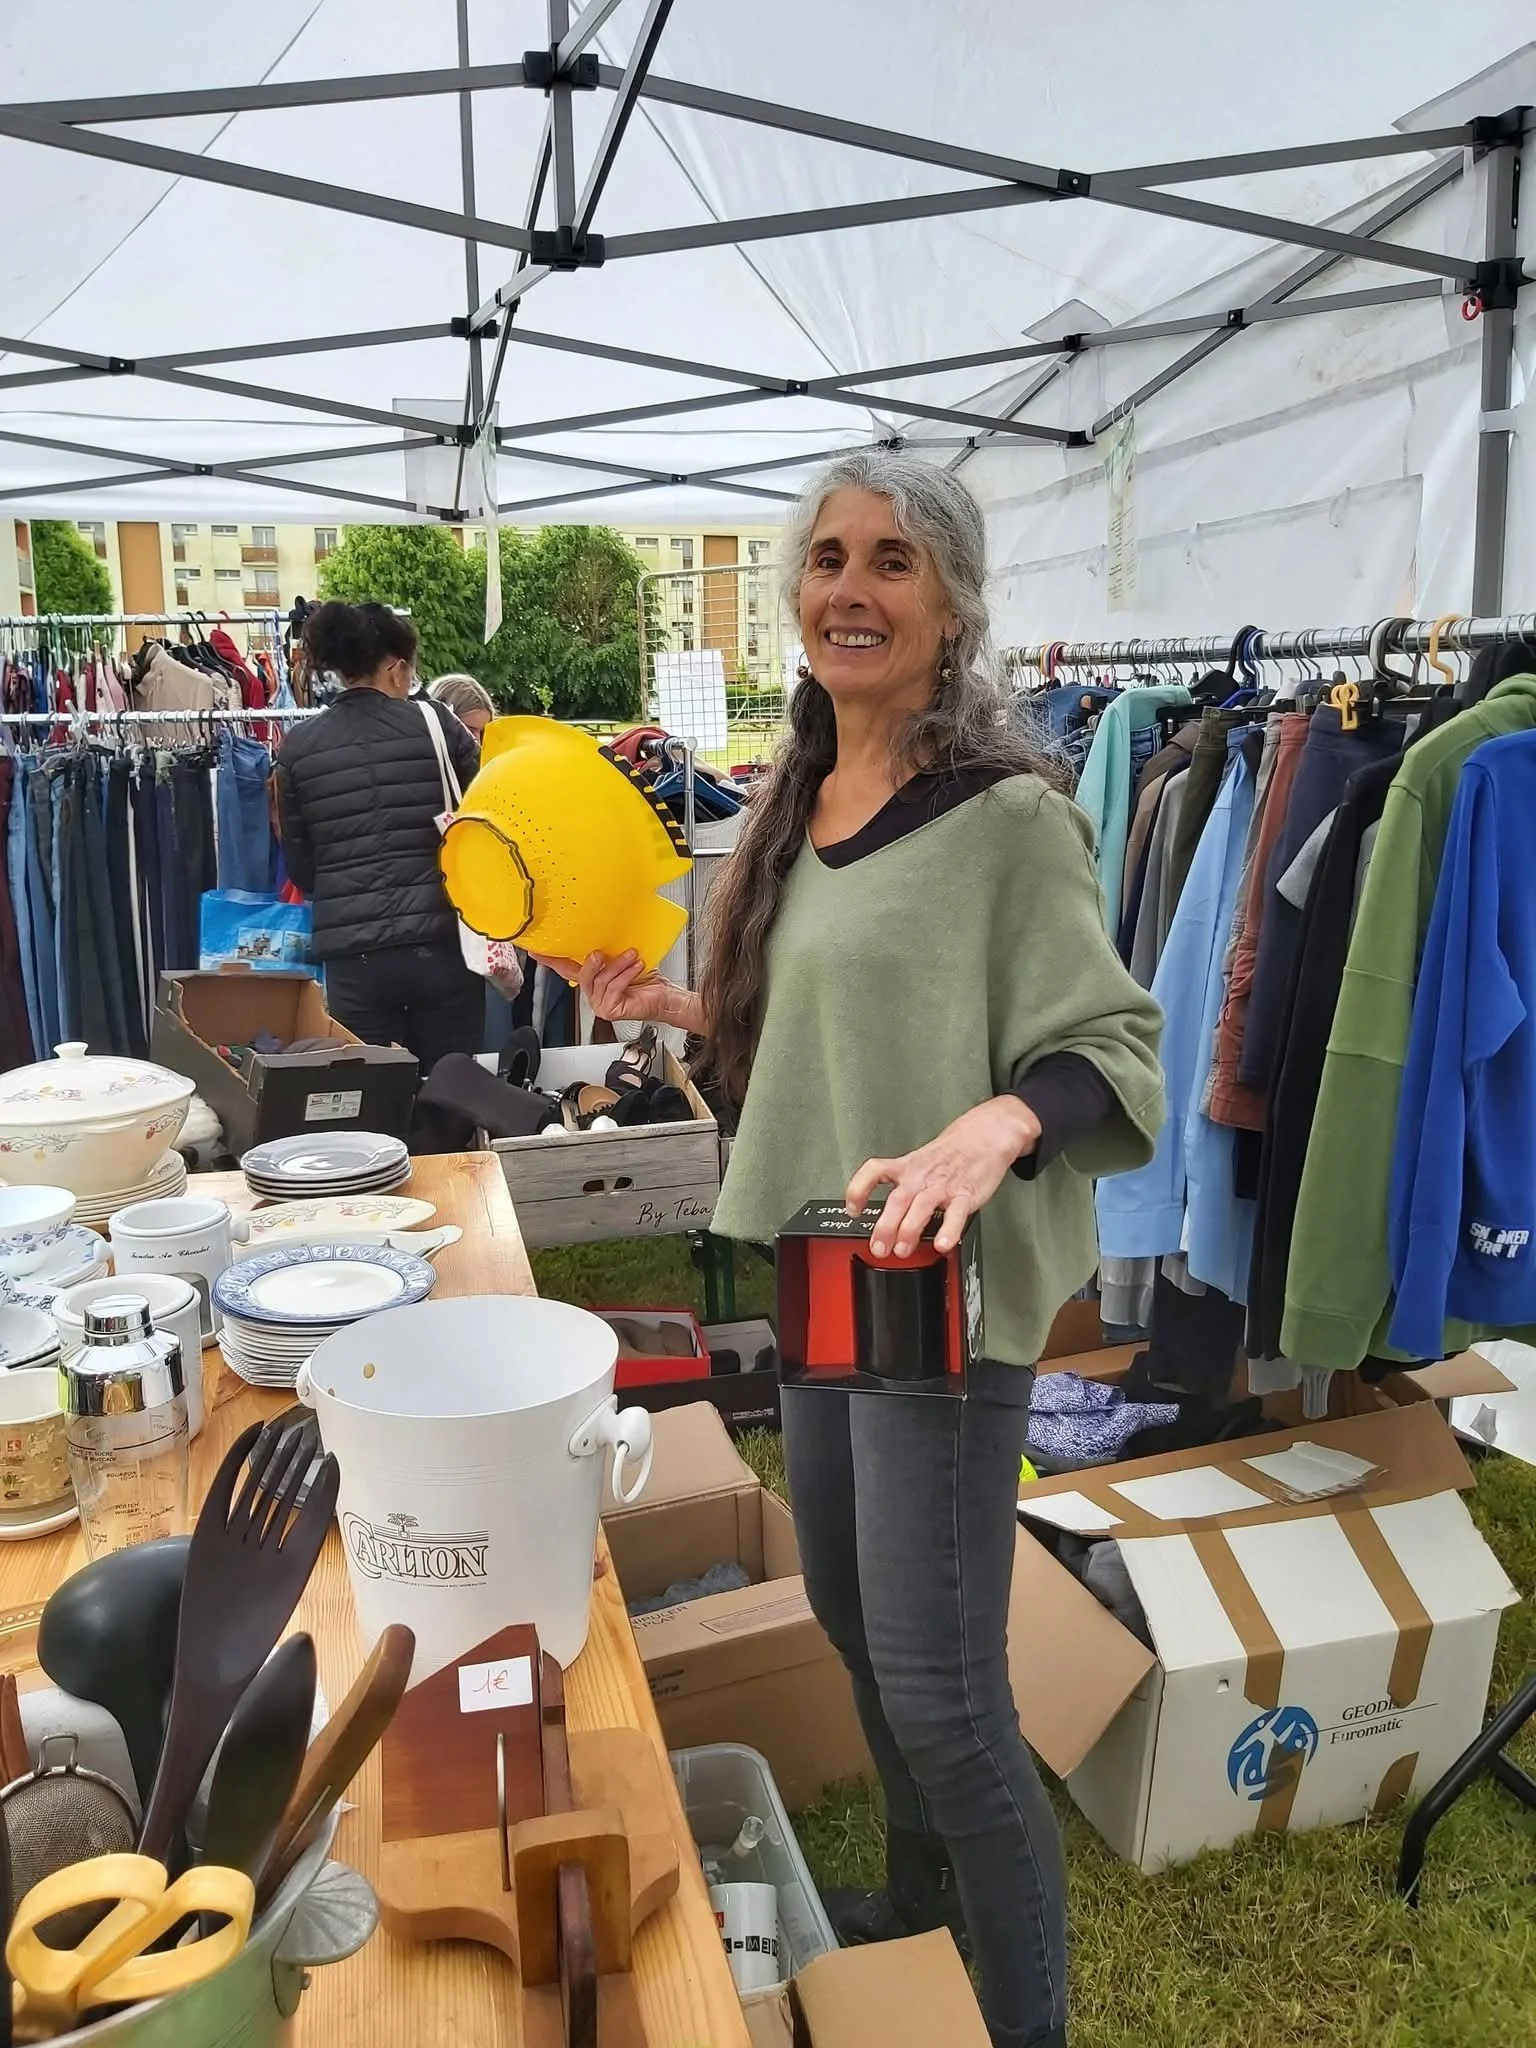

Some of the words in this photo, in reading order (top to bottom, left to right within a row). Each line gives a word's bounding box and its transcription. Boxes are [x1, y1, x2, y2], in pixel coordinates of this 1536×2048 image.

[635, 1202, 667, 1228] By
[673, 1197, 712, 1220] Teba
[819, 1219, 854, 1230] plus
[343, 1511, 488, 1580] CARLTON
[472, 1669, 510, 1694] 1€
[1342, 1698, 1401, 1720] GEODI
